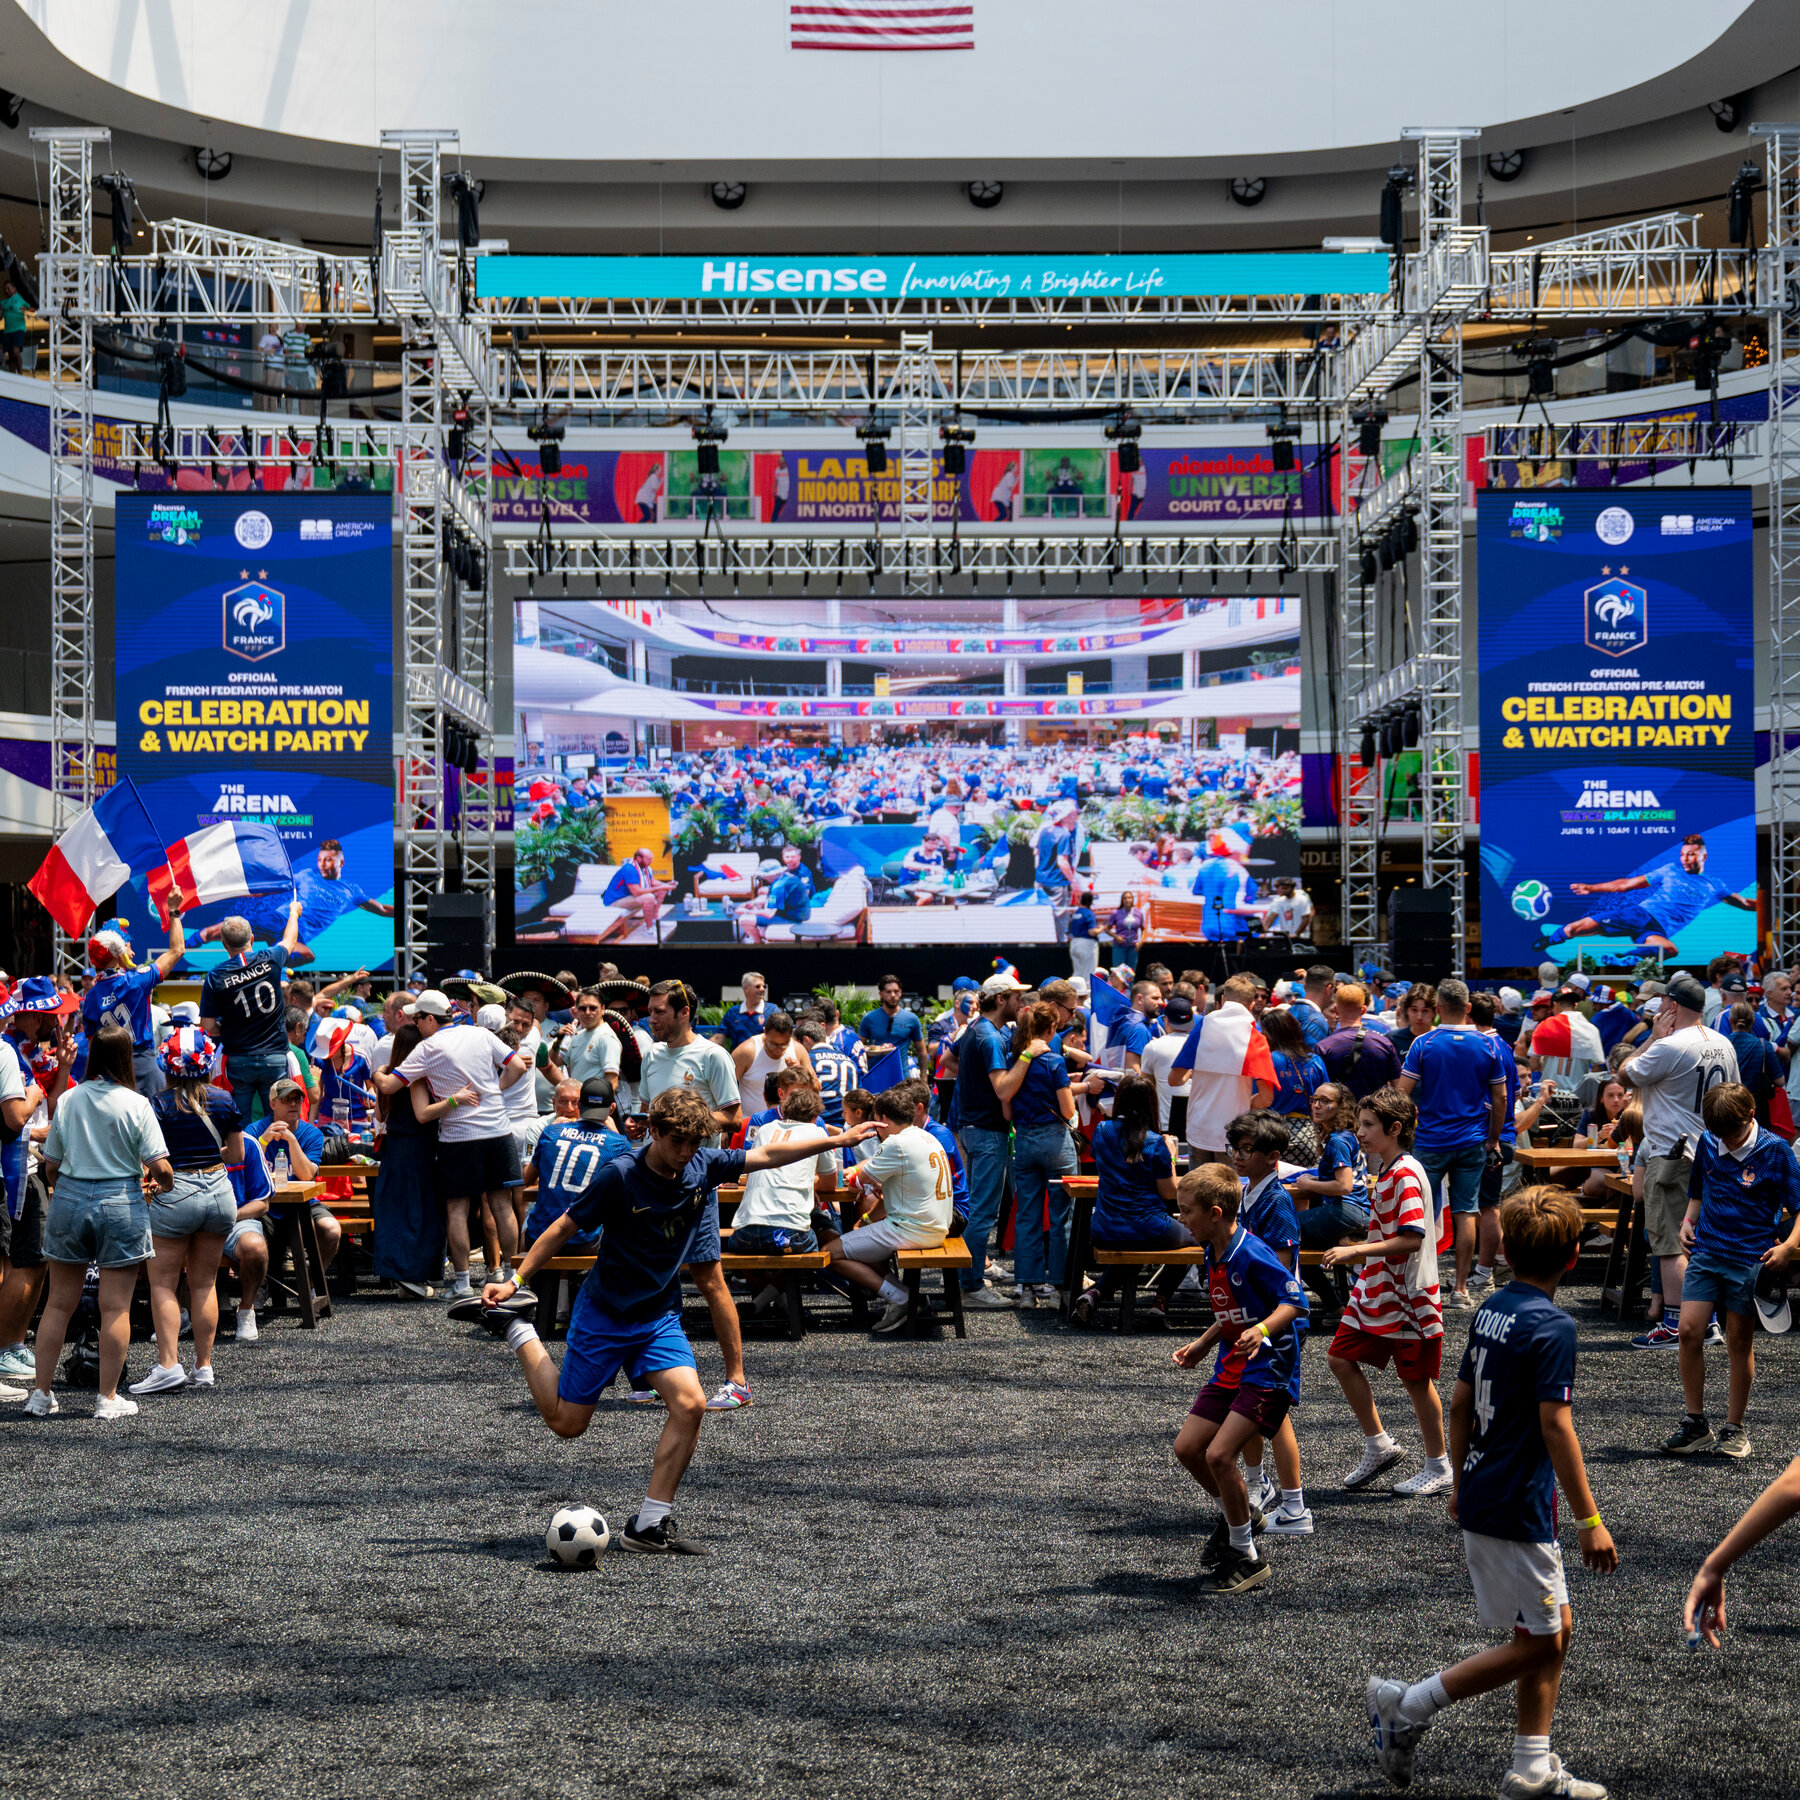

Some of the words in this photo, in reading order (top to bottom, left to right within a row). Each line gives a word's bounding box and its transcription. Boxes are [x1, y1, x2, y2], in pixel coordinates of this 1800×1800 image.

[702, 262, 887, 292] Hisense
[900, 262, 1011, 297] Innovating
[1020, 275, 1031, 291] A
[1040, 270, 1123, 296] Brighter
[1125, 268, 1166, 295] Life
[798, 481, 859, 502] INDOOR
[1169, 475, 1301, 497] UNIVERSE
[153, 504, 185, 512] Hisense
[580, 503, 590, 516] 1
[798, 504, 817, 517] IN
[1169, 500, 1222, 513] COURT
[1293, 498, 1303, 510] 1
[151, 511, 198, 522] DREAM
[1512, 507, 1560, 518] DREAM
[336, 522, 374, 530] AMERICAN
[1696, 517, 1735, 526] AMERICAN
[233, 636, 274, 645] FRANCE
[1595, 632, 1636, 641] FRANCE
[228, 672, 277, 683] OFFICIAL
[1590, 669, 1640, 679] OFFICIAL
[166, 686, 209, 696] FRENCH
[211, 686, 278, 696] FEDERATION
[279, 685, 343, 696] PRE-MATCH
[1528, 682, 1572, 692] FRENCH
[1574, 682, 1640, 692] FEDERATION
[1642, 681, 1705, 691] PRE-MATCH
[139, 699, 369, 726] CELEBRATION
[1501, 694, 1732, 722] CELEBRATION
[139, 730, 161, 752] &
[166, 730, 268, 752] WATCH
[274, 730, 369, 752] PARTY
[1502, 727, 1525, 748] &
[1530, 726, 1632, 748] WATCH
[1637, 725, 1732, 747] PARTY
[220, 784, 245, 794] THE
[1583, 780, 1608, 790] THE
[212, 795, 297, 813] ARENA
[1575, 790, 1660, 808] ARENA
[280, 831, 307, 839] LEVEL
[1560, 827, 1584, 835] JUNE
[1585, 827, 1595, 835] 16
[1607, 826, 1630, 834] 10AM
[1642, 826, 1668, 834] LEVEL
[224, 961, 272, 989] FRANCE
[233, 981, 276, 1018] 10
[815, 1060, 858, 1097] 20
[560, 1127, 607, 1145] MBAPPE
[548, 1139, 600, 1193] 10
